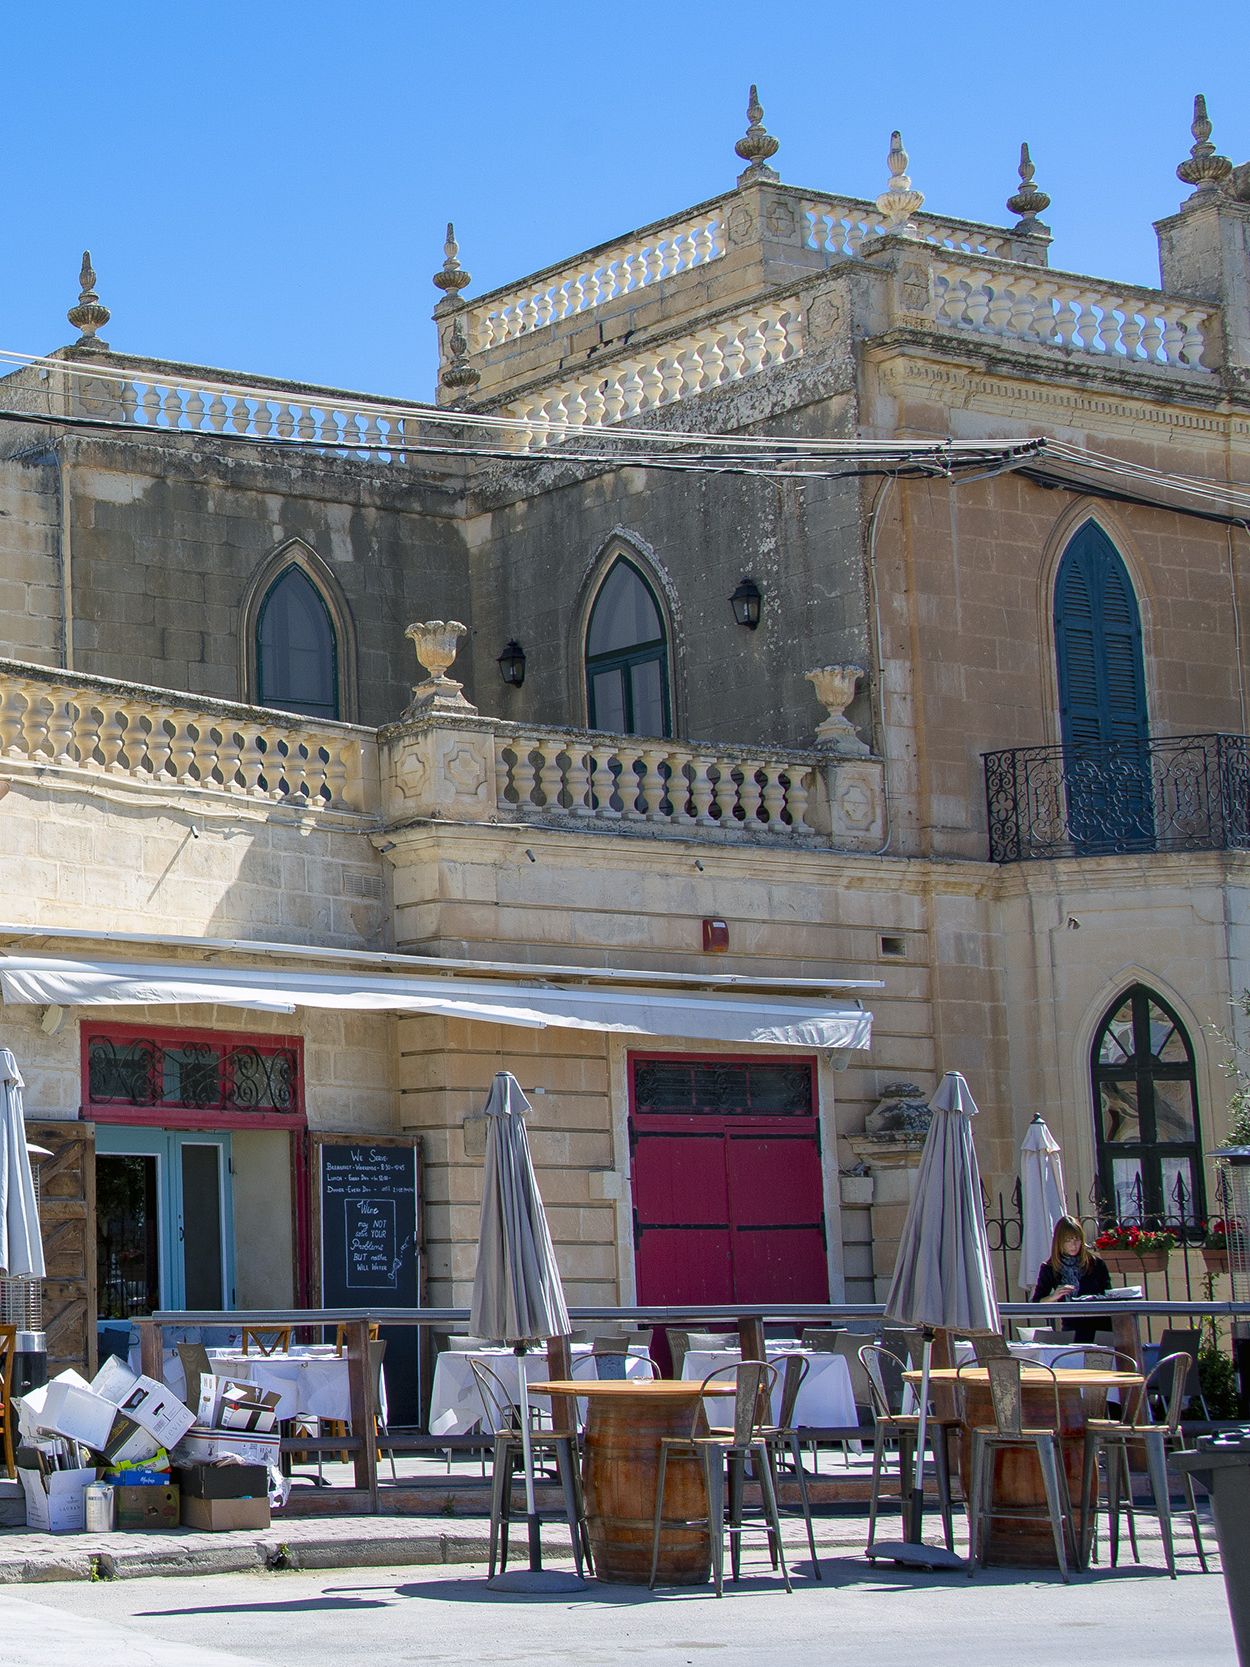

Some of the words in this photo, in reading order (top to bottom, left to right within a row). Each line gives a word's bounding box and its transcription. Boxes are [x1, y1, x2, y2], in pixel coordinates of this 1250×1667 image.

[373, 1219, 387, 1228] NOT
[371, 1230, 387, 1238] YOUR
[353, 1253, 367, 1261] BUT
